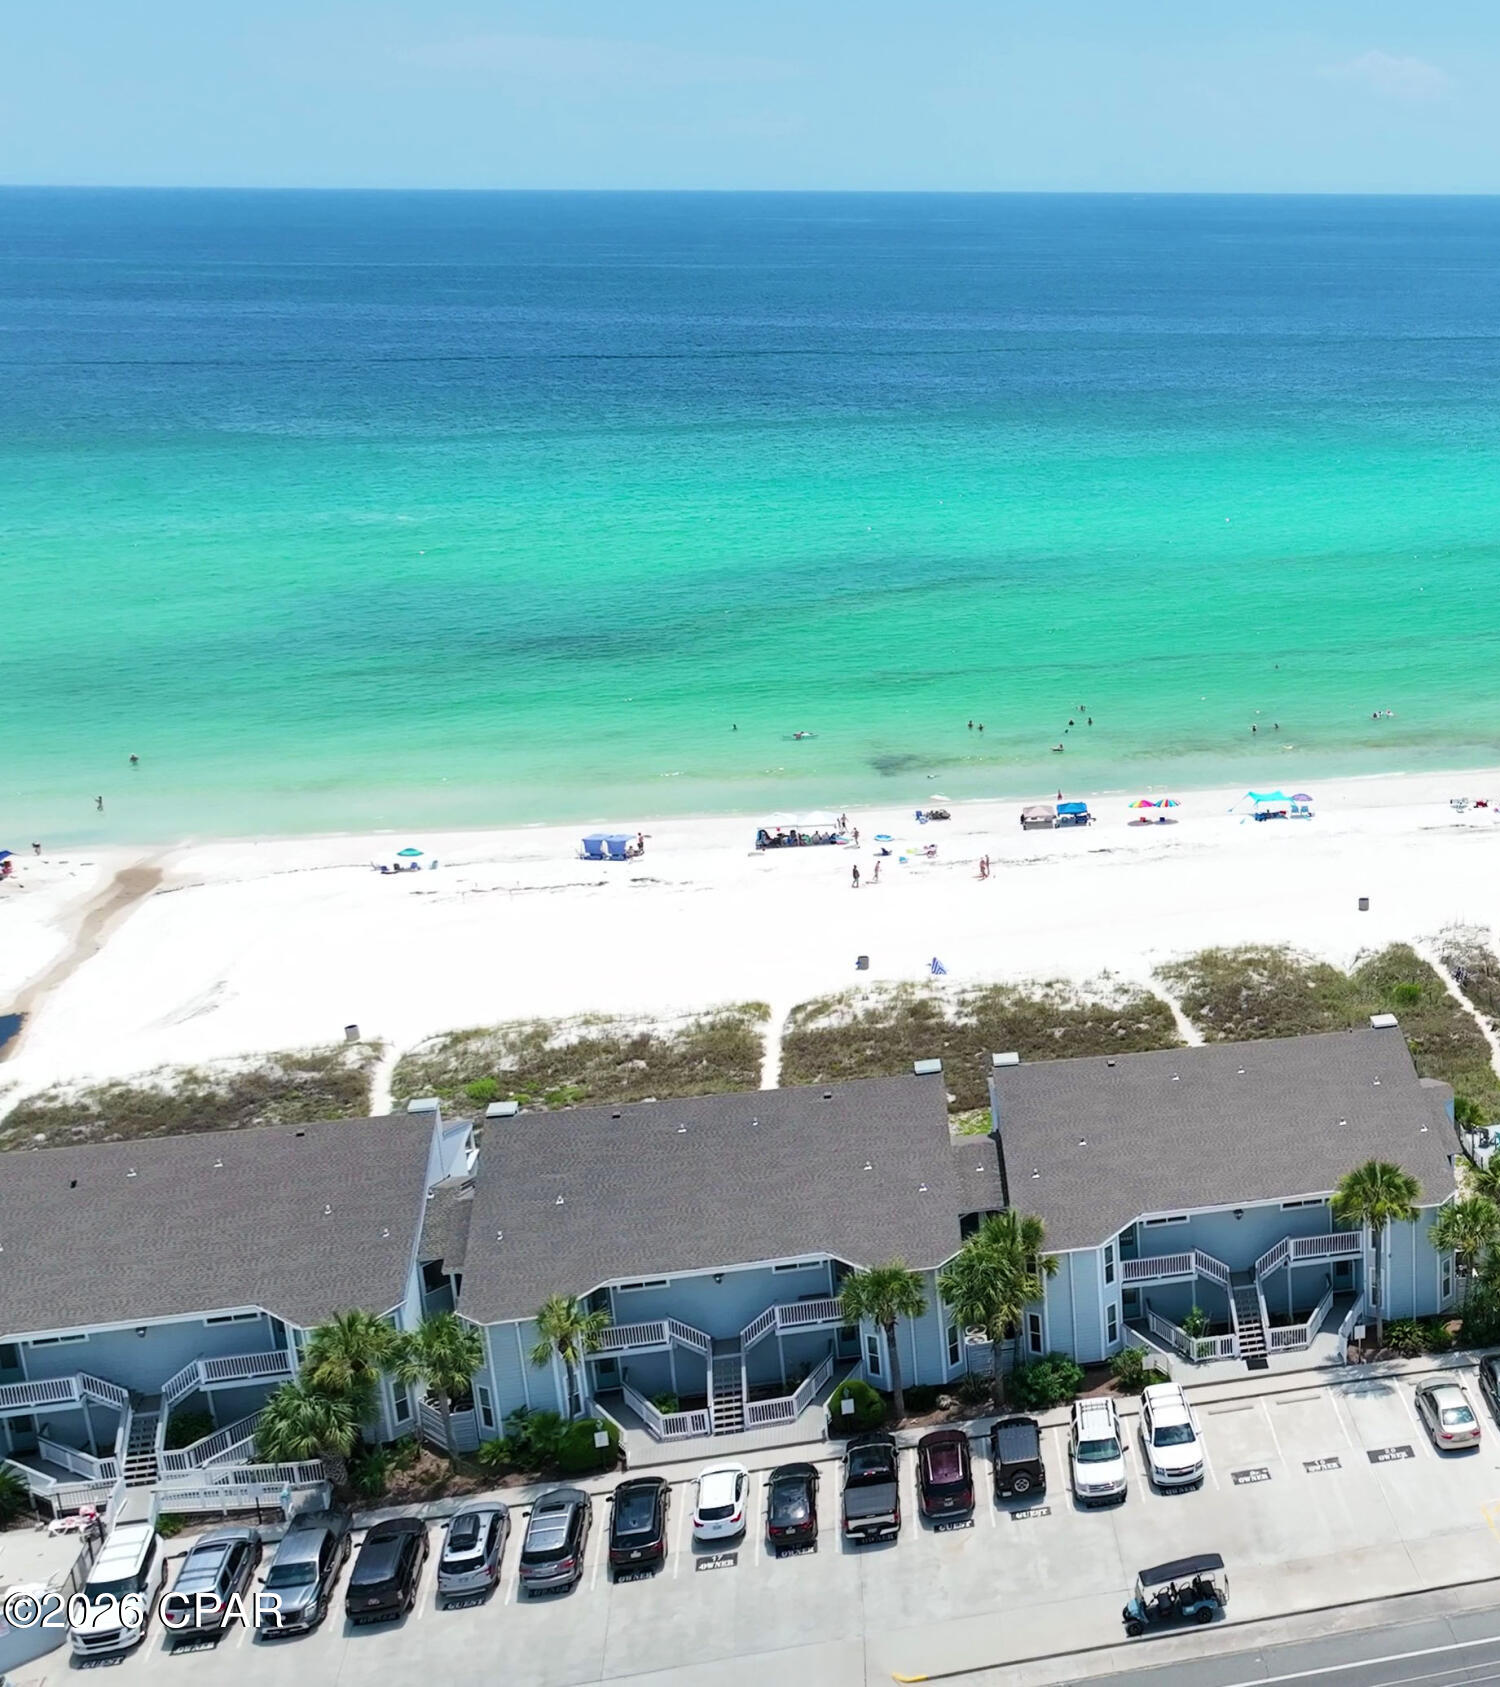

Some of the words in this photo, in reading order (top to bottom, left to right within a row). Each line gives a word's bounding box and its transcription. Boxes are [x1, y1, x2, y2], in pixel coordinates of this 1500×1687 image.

[938, 1519, 972, 1531] GUEST
[698, 1558, 734, 1571] OWNER
[617, 1571, 654, 1583] OWNER
[447, 1598, 486, 1610] GUEST
